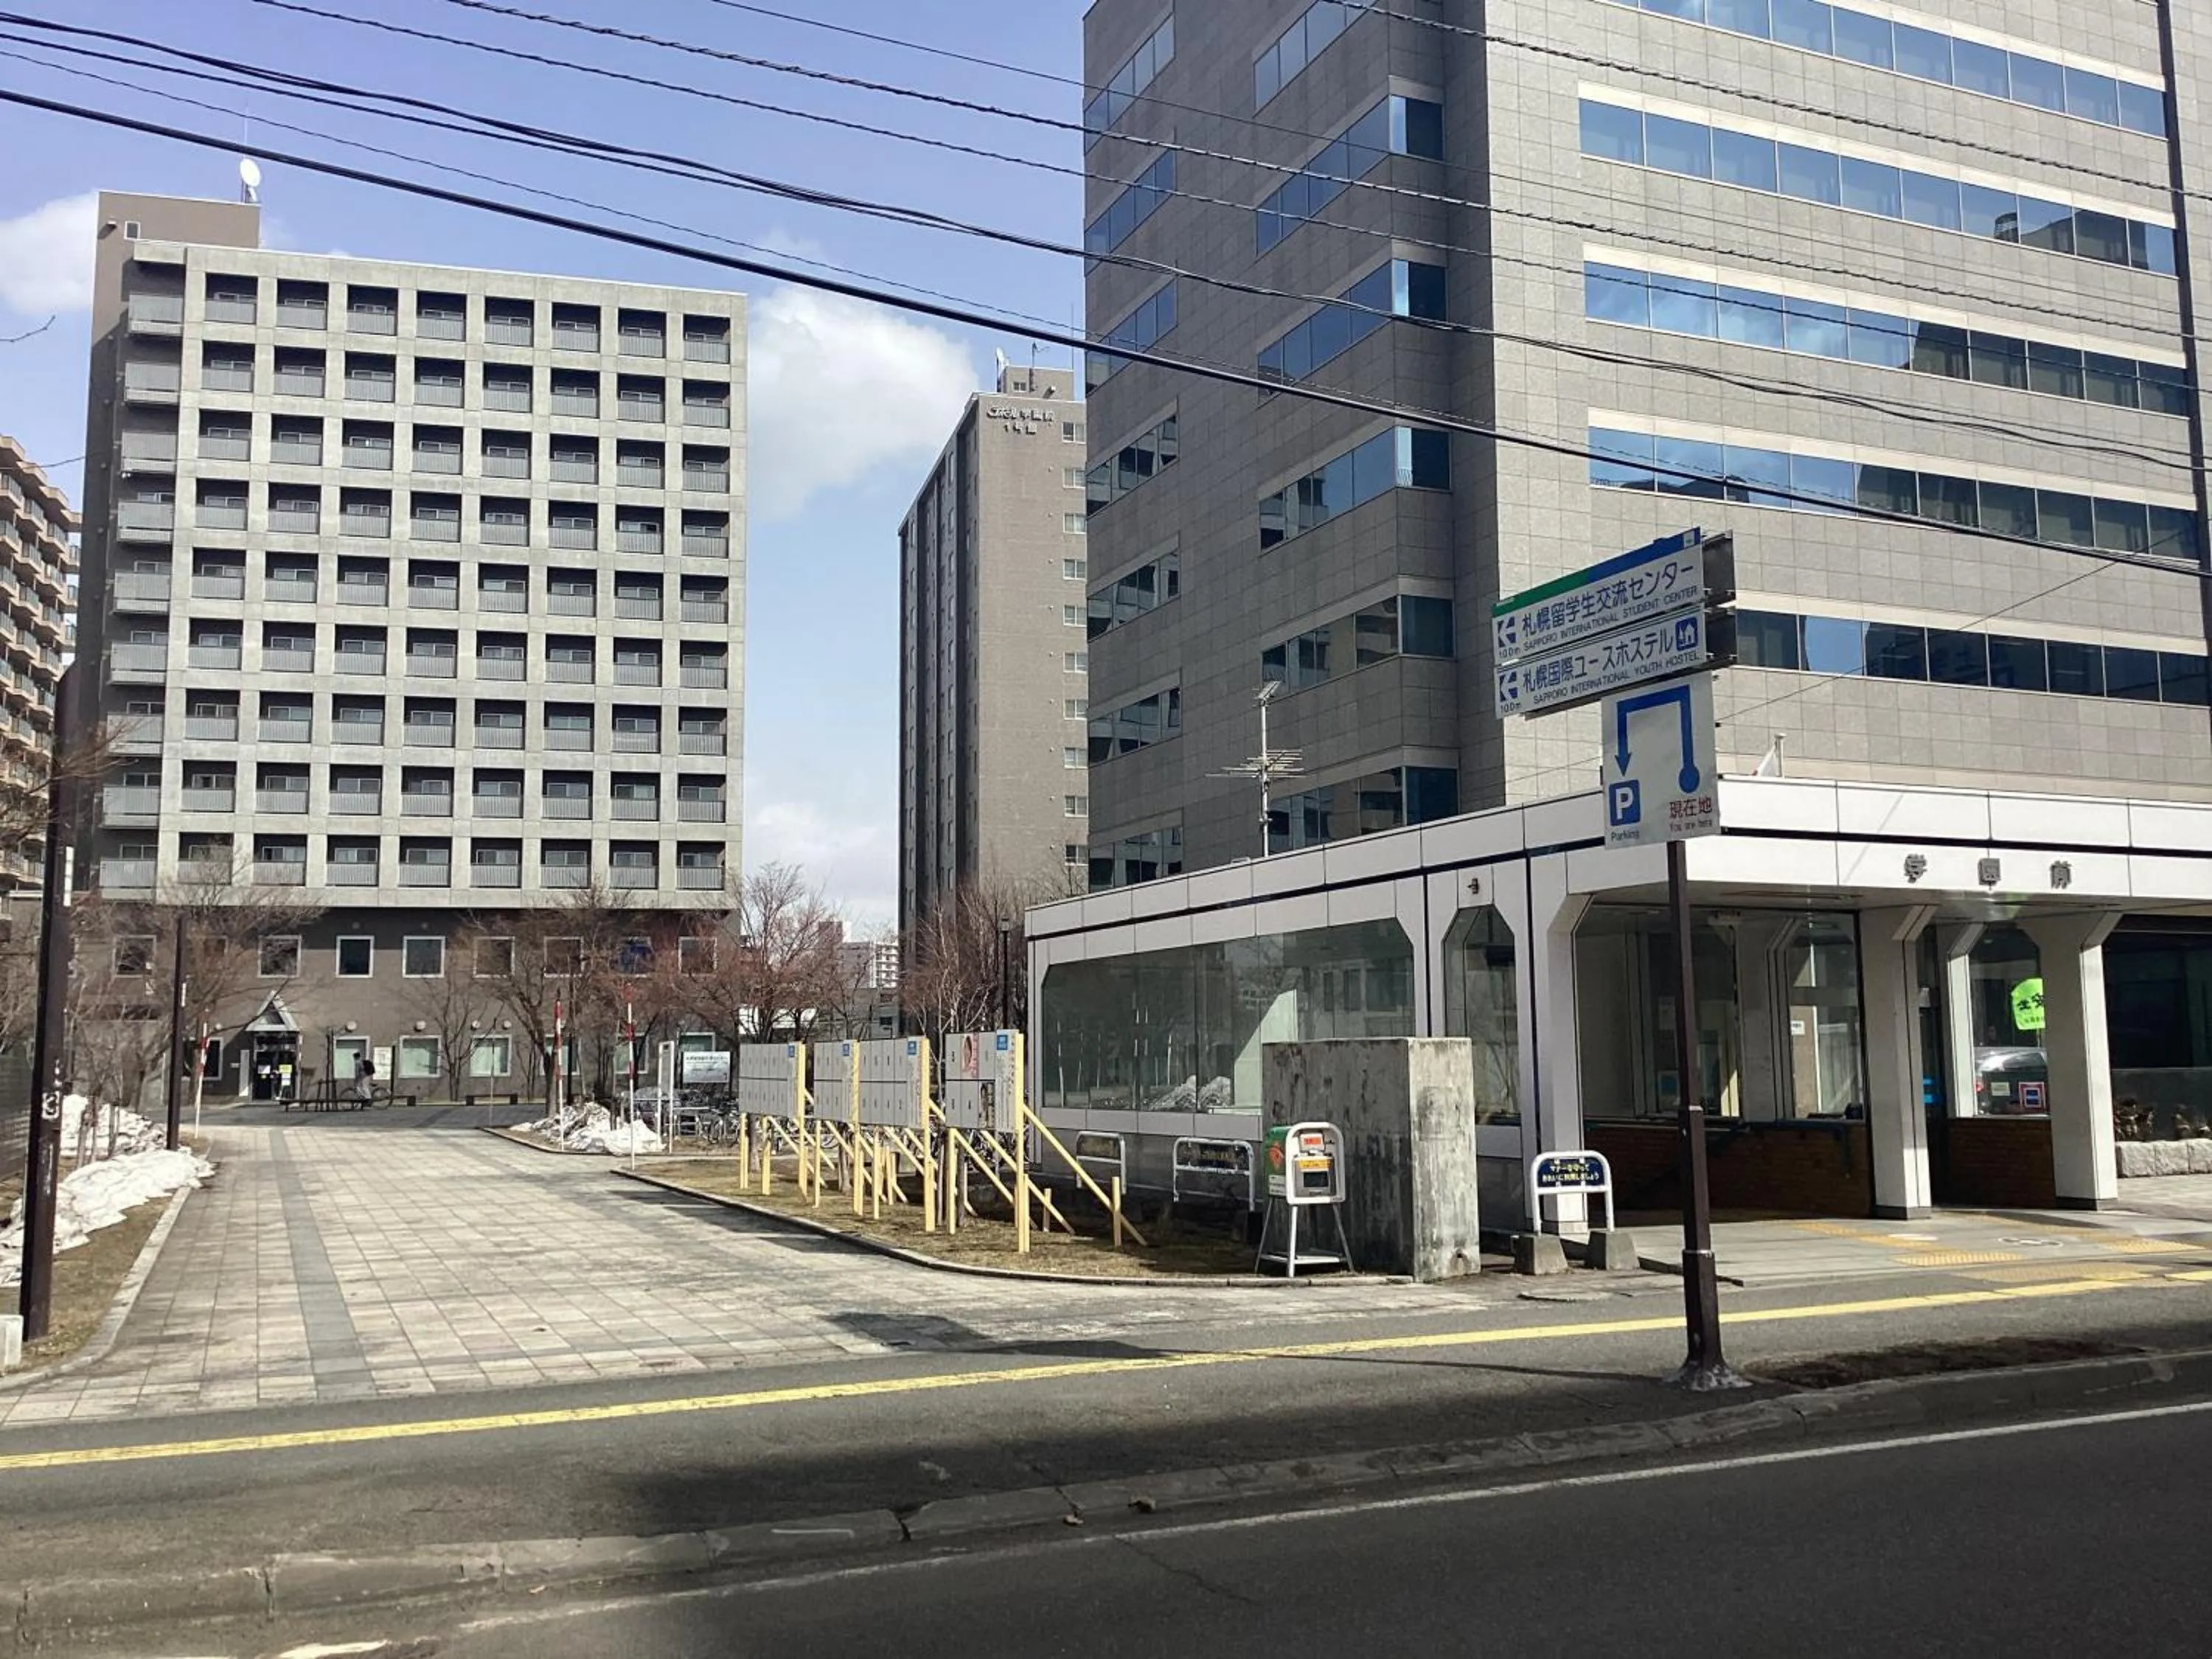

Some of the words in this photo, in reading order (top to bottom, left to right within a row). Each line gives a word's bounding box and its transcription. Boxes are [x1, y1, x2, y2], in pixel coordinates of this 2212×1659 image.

[1523, 562, 1694, 637] 札幌留学生交流センター
[1523, 633, 1558, 650] SAPPORO
[1561, 613, 1618, 639] INTERNATIONAL
[1623, 598, 1661, 618] STUDENT
[1663, 585, 1698, 605] CENTER
[1523, 628, 1673, 693] 札幌国際ユースホステル
[1534, 686, 1568, 704] SAPPORO
[1571, 670, 1630, 694] INTERNATIONAL
[1635, 661, 1662, 675] YOUTH
[1666, 653, 1700, 667] HOSTEL
[1615, 787, 1633, 820] P
[1669, 796, 1712, 818] 現在地
[1611, 830, 1640, 841] Parking
[1904, 854, 2072, 889] 学園前
